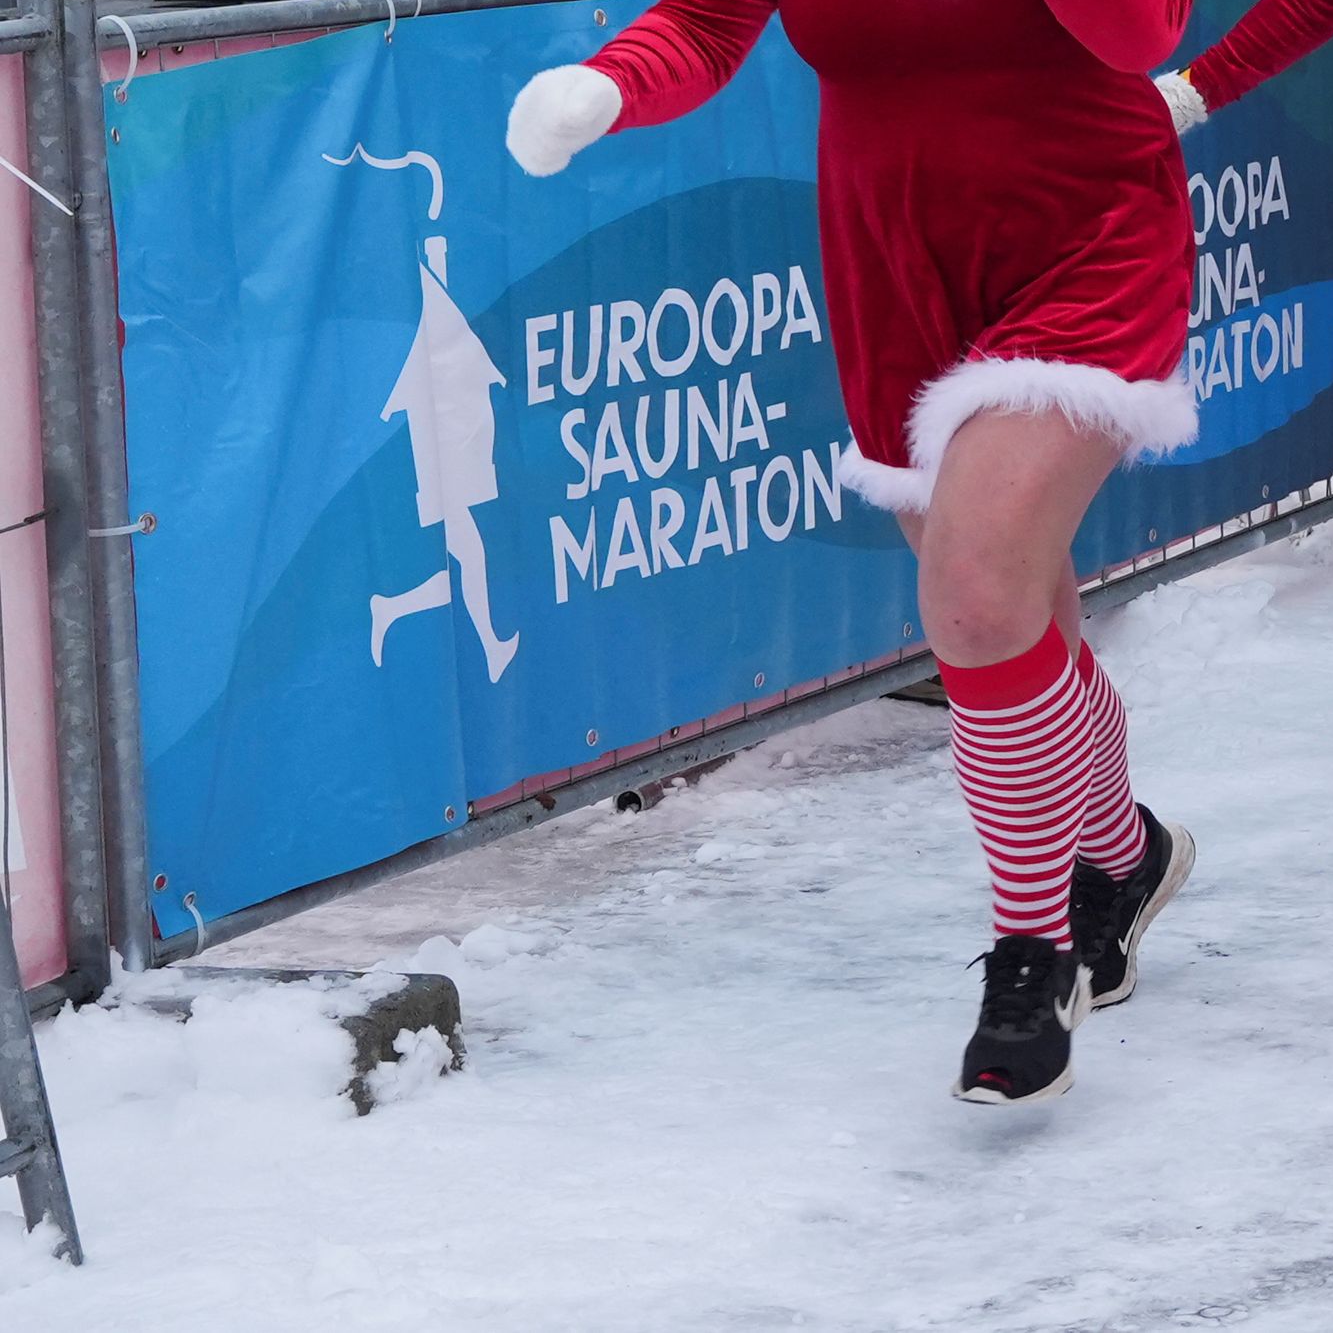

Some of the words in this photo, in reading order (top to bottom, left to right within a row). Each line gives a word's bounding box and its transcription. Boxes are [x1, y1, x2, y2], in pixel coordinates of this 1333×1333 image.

[1188, 155, 1290, 246] OOPA
[524, 265, 822, 406] EUROOPA
[1187, 302, 1304, 402] RATON
[559, 372, 787, 501] SAUNA-
[549, 442, 844, 605] MARATON
